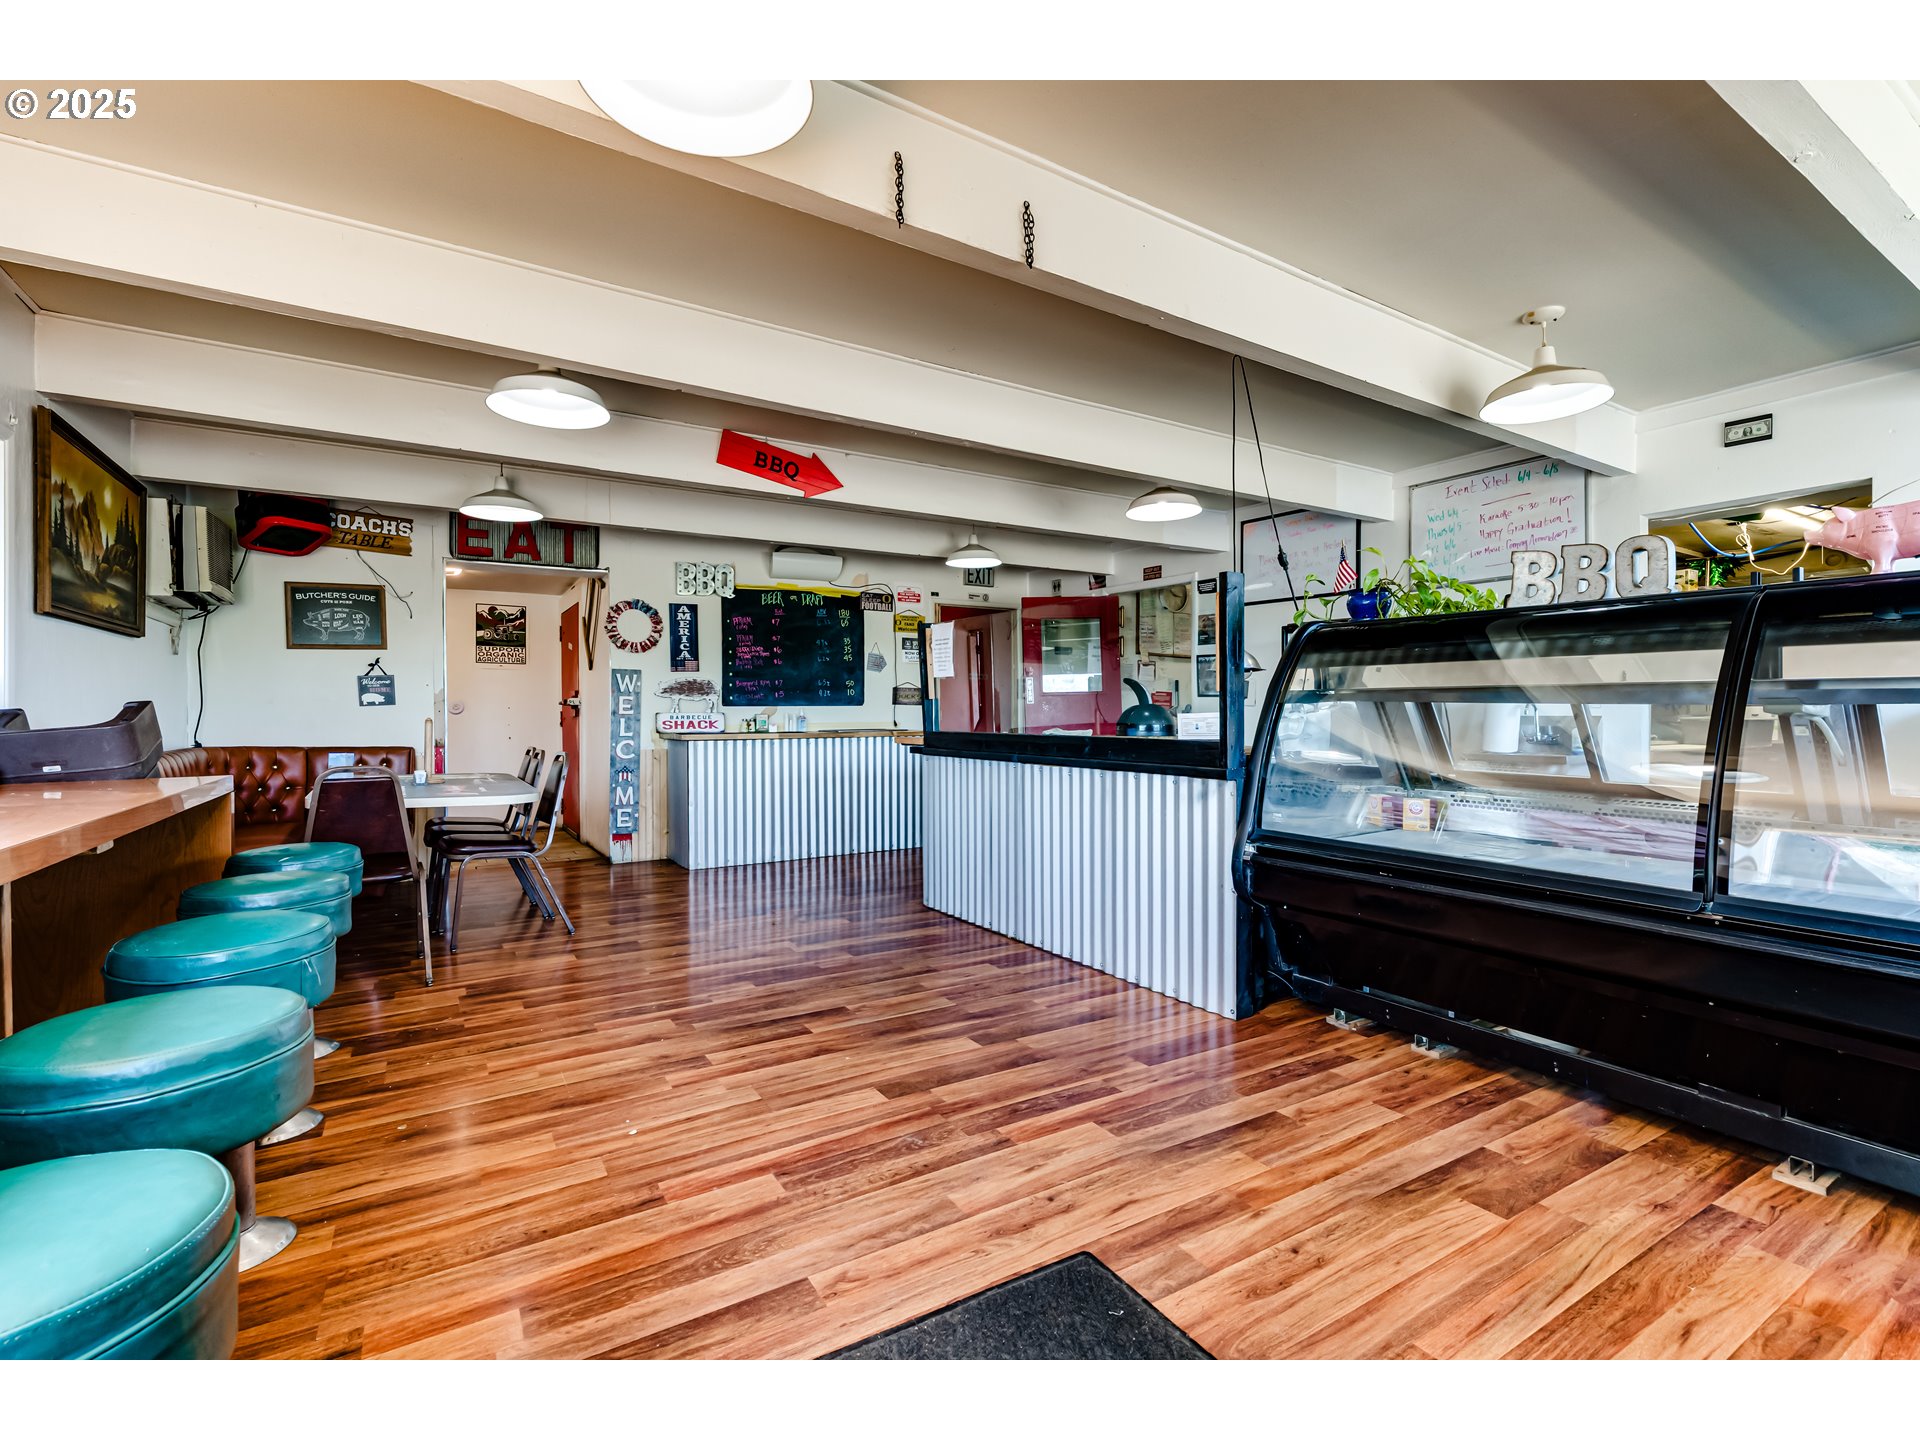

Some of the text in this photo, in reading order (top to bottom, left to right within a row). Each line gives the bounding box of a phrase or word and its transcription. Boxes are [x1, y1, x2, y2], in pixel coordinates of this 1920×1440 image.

[753, 450, 800, 482] BBQ
[338, 530, 394, 549] TABLE
[457, 512, 588, 563] EAT
[675, 562, 736, 598] BBQ
[967, 568, 992, 585] EXIT
[1504, 535, 1672, 608] BBQ
[295, 592, 376, 602] BUTCHER'S GUIDE
[761, 592, 784, 607] BEER
[801, 593, 824, 607] DRAFT
[861, 602, 892, 611] FOOTBALL
[677, 605, 692, 658] AMERICA
[662, 719, 719, 730] SHACK
